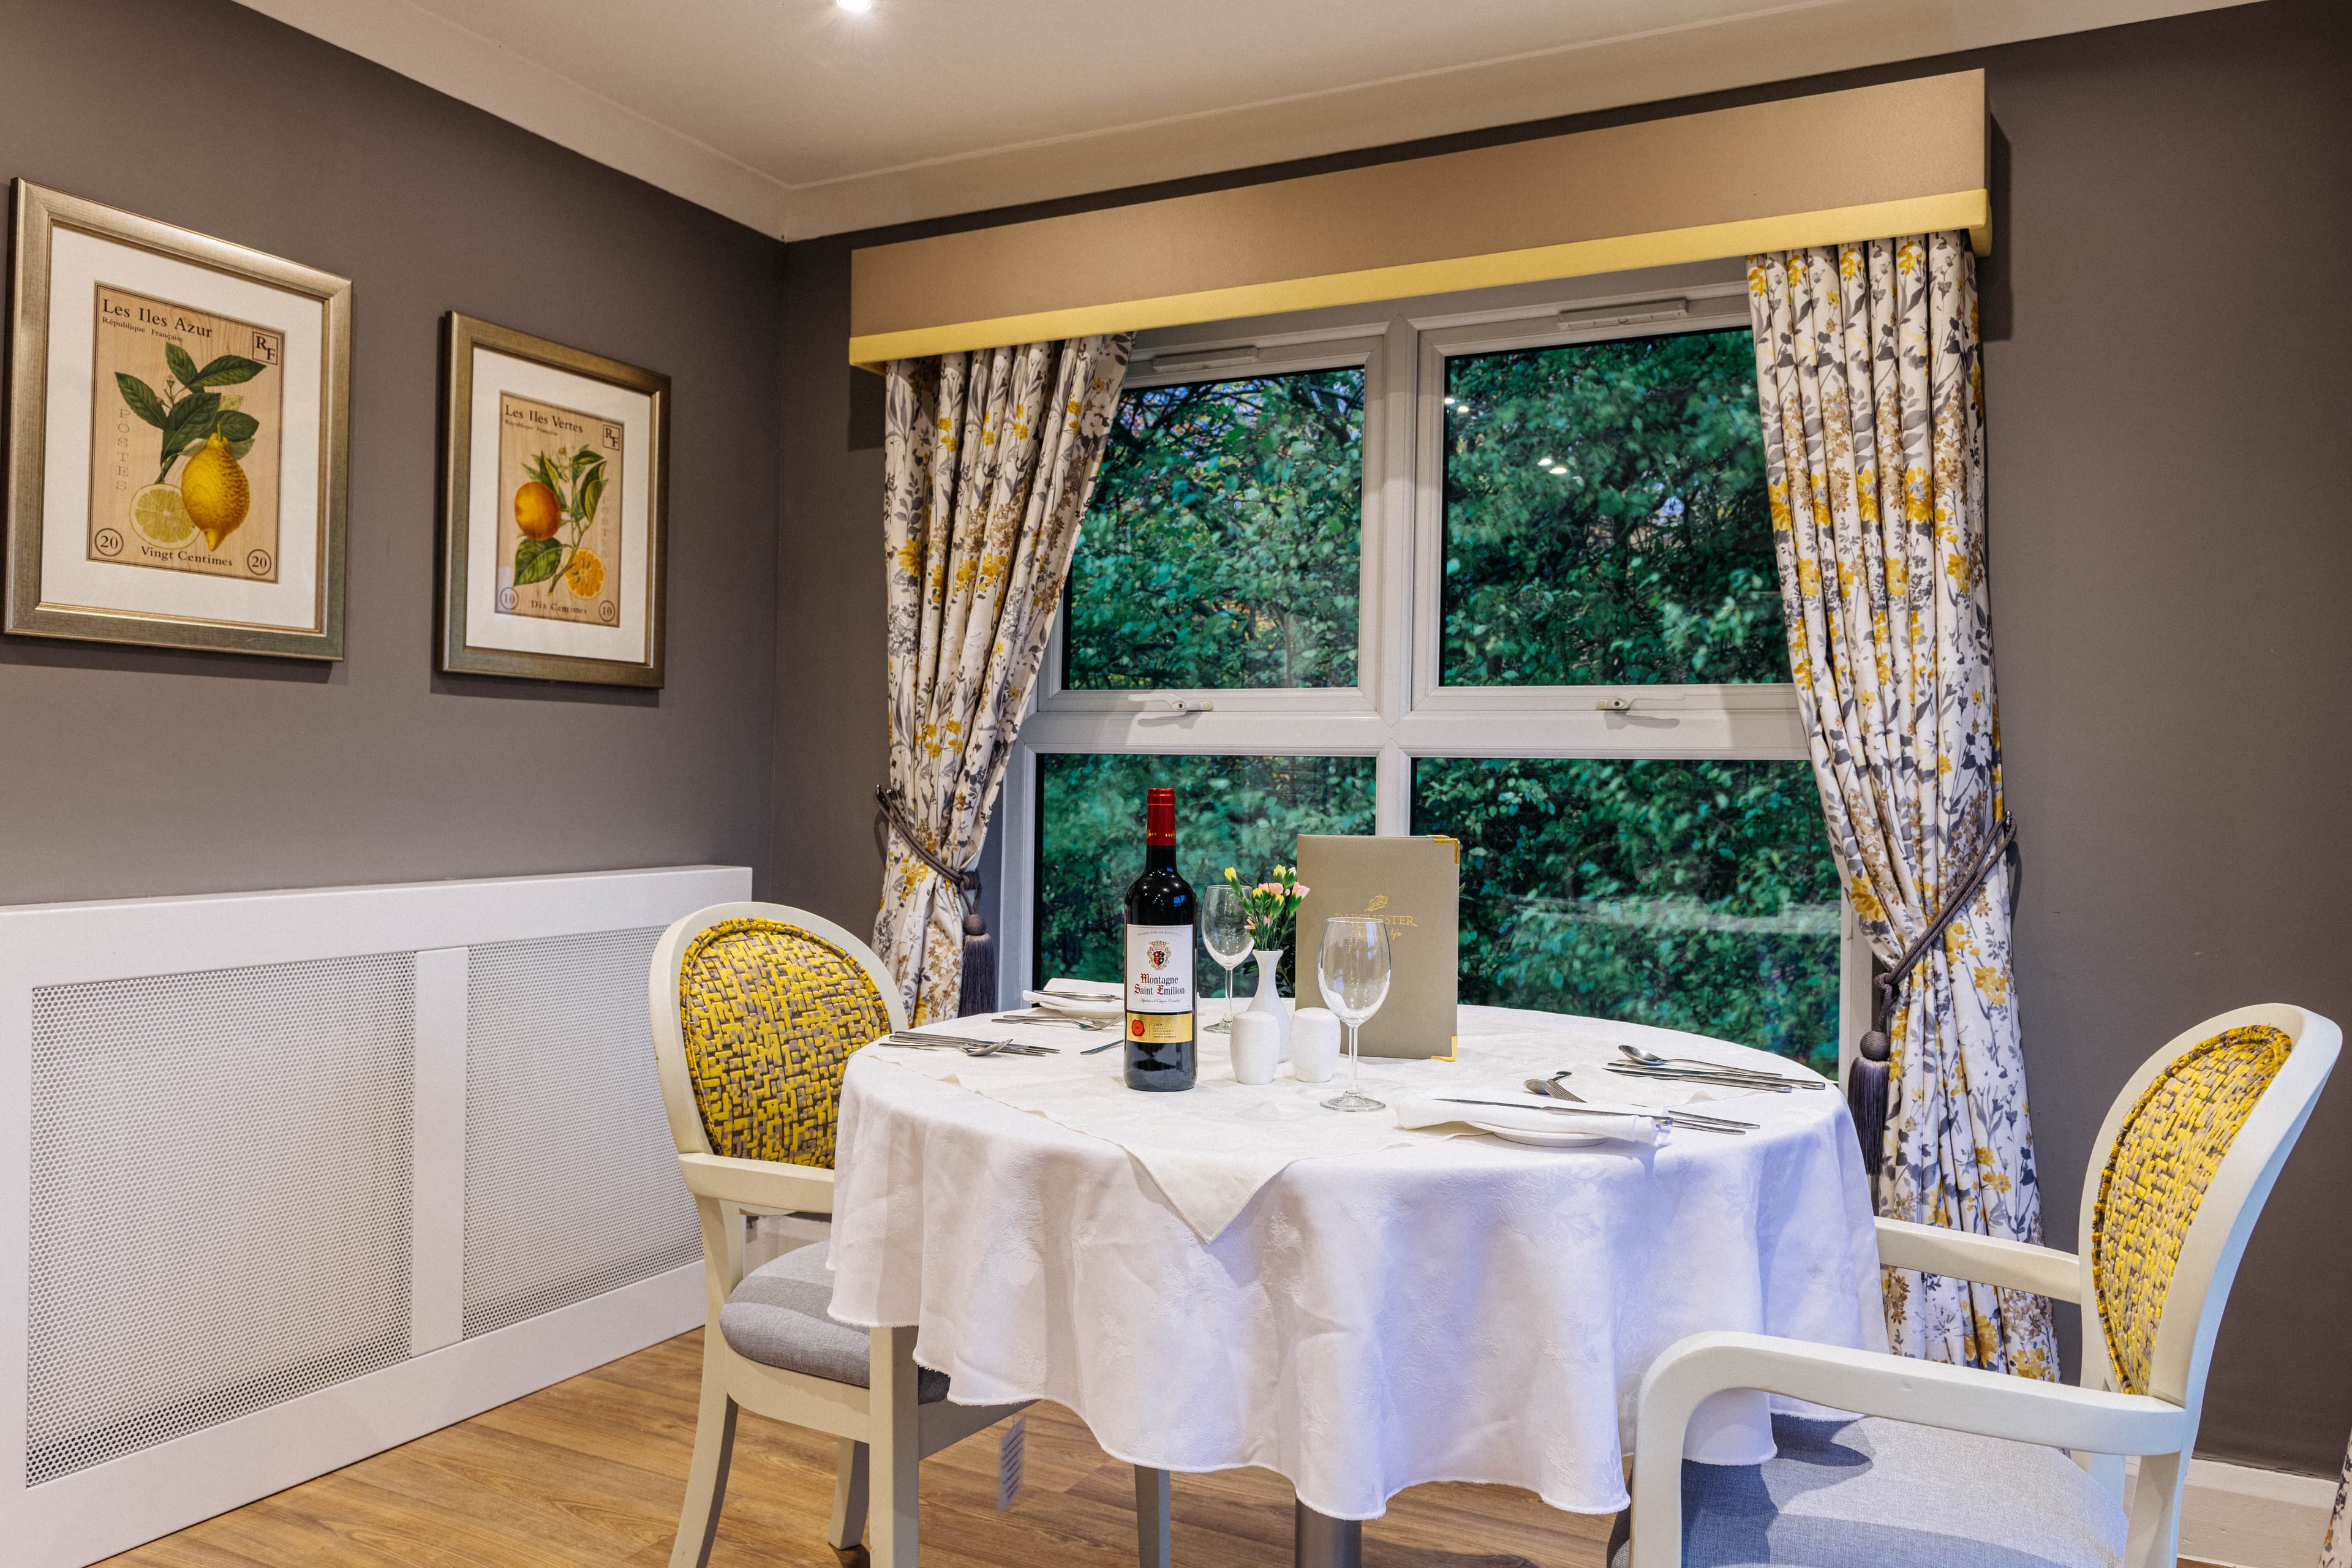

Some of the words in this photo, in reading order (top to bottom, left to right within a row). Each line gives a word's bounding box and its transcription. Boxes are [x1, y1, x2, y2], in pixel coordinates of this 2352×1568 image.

[103, 299, 130, 317] Les
[138, 307, 167, 327] Iles
[174, 317, 213, 337] Azur
[102, 317, 145, 333] République
[505, 404, 524, 418] Les
[529, 410, 548, 424] Iles
[552, 415, 583, 433] Vertes
[116, 409, 130, 491] POSTES
[100, 535, 118, 548] 20
[141, 546, 173, 561] Vingt
[178, 550, 233, 567] Centimes
[252, 556, 267, 568] 20
[503, 592, 515, 603] 10
[531, 600, 547, 609] Dix
[551, 603, 587, 614] Centimes
[602, 606, 612, 616] 10
[1390, 928, 1402, 940] life
[1140, 973, 1178, 986] Montagne
[1134, 984, 1153, 995] Saint
[1157, 984, 1185, 995] Emilion
